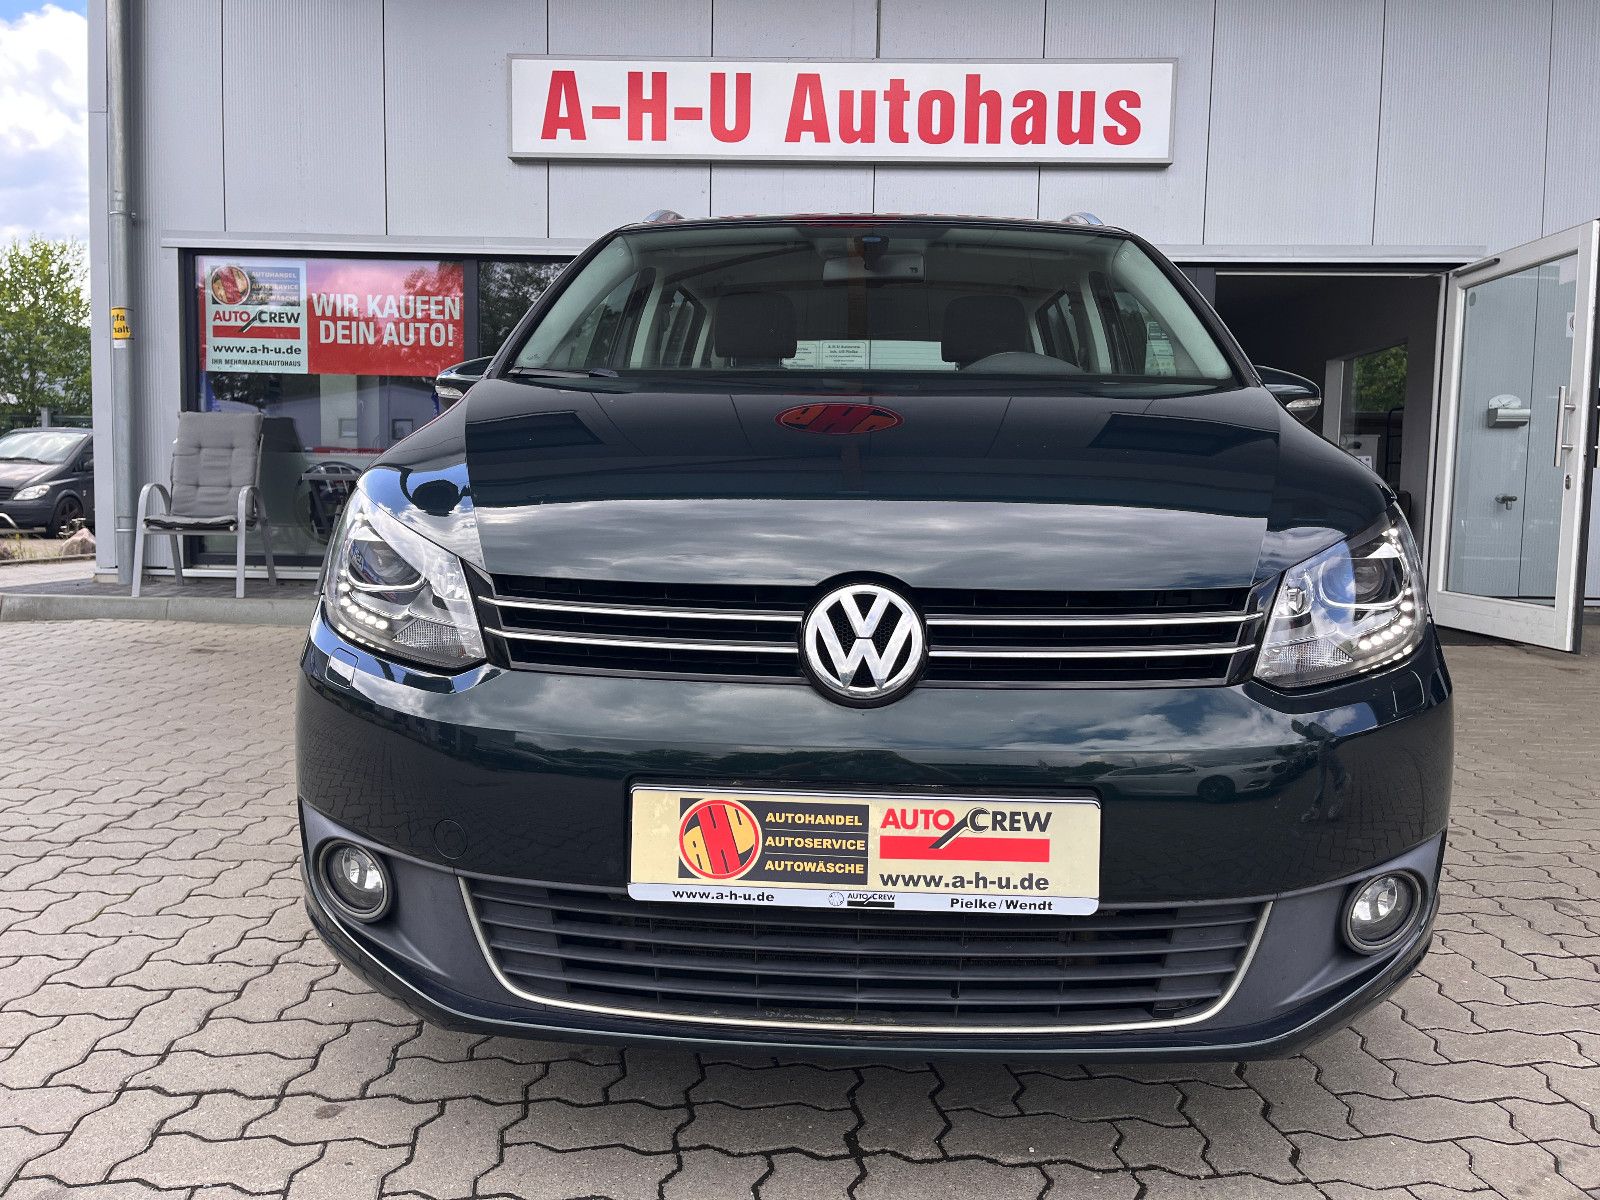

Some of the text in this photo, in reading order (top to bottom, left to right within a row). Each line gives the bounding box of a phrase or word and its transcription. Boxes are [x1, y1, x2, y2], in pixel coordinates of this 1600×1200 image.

[541, 70, 1142, 146] A-H-U Autohaus
[311, 293, 460, 320] WIR KAUFEN
[213, 310, 300, 323] AUTO CREW
[319, 320, 454, 347] DEIN AUTO!
[213, 345, 301, 354] www.a-h-u.de
[766, 812, 863, 826] AUTOHANDEL
[880, 808, 1053, 833] AUTO CREW
[765, 836, 866, 851] AUTOSERVICE
[765, 860, 865, 875] AUTOWÄSCHE
[879, 872, 1050, 891] www.a-h-u.de
[672, 890, 775, 902] www.a-h-u.de
